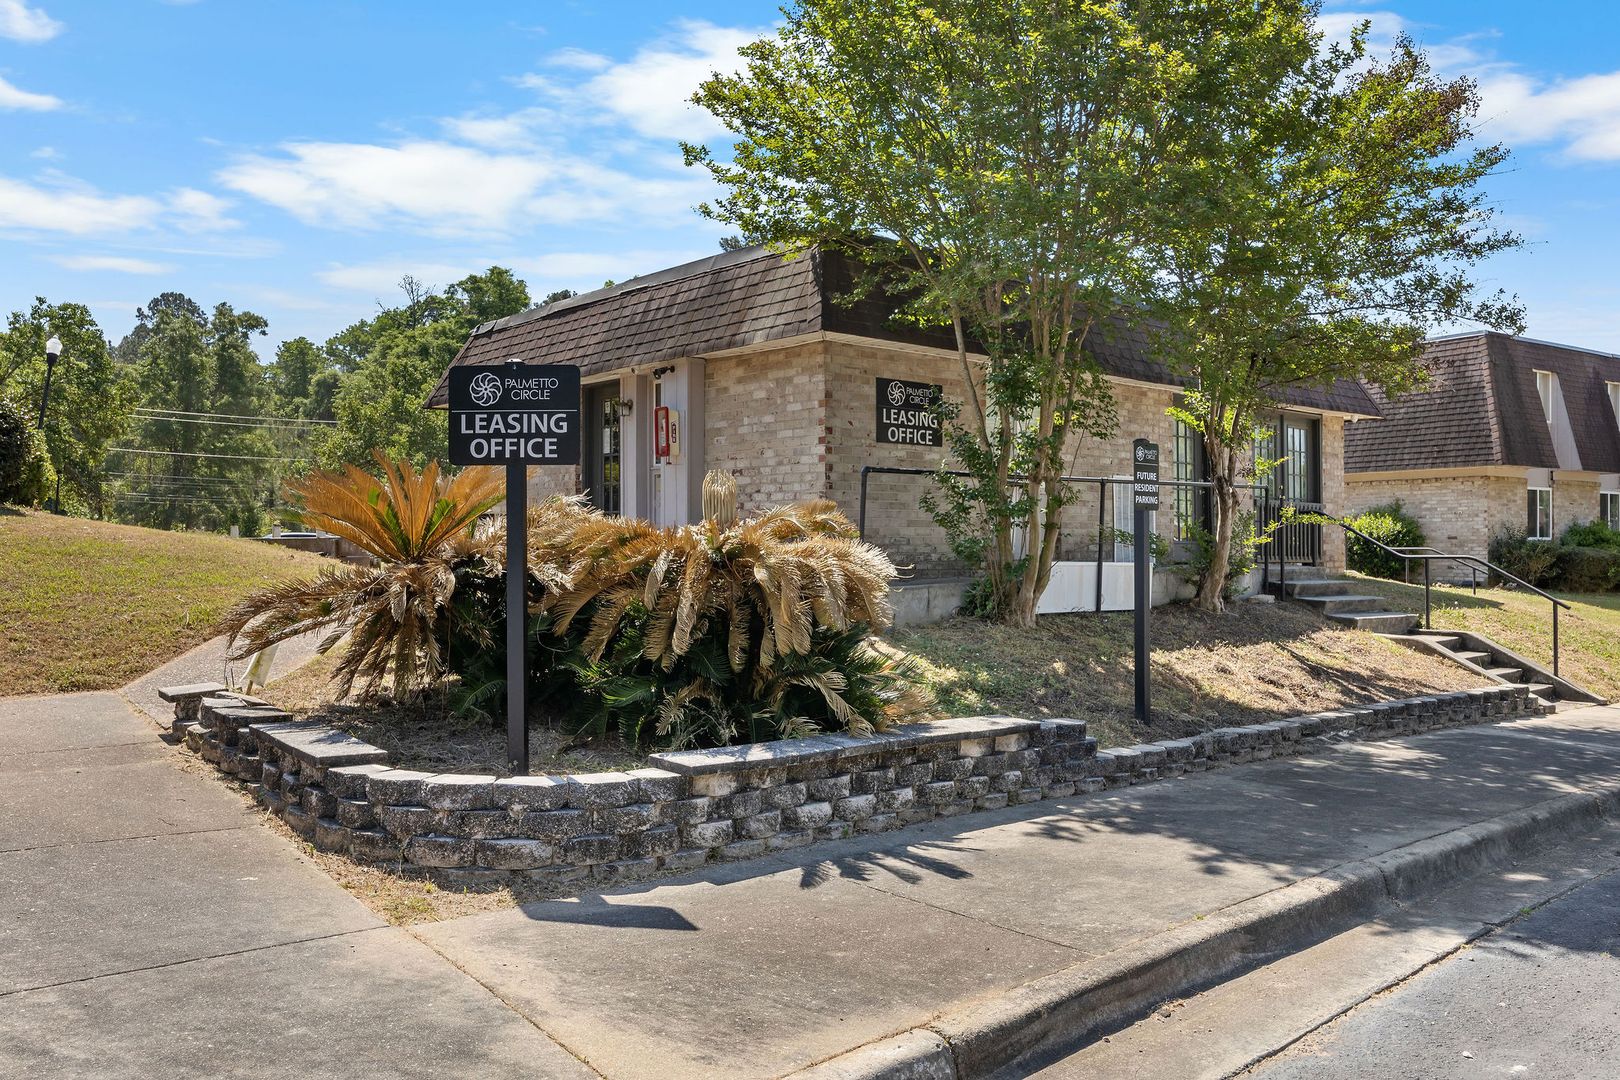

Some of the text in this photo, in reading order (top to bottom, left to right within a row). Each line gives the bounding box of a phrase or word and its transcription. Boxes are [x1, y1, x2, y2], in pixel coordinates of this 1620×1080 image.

[505, 378, 558, 389] PALMETTO
[511, 389, 550, 400] CIRCLE
[906, 387, 933, 398] PALMETTO
[909, 396, 929, 405] CIRCLE
[461, 413, 568, 434] LEASING
[883, 408, 938, 428] LEASING
[888, 427, 933, 445] OFFICE
[469, 438, 558, 459] OFFICE
[1136, 472, 1157, 480] FUTURE
[1135, 484, 1159, 493] RESIDENT
[1136, 496, 1158, 504] PARKING
